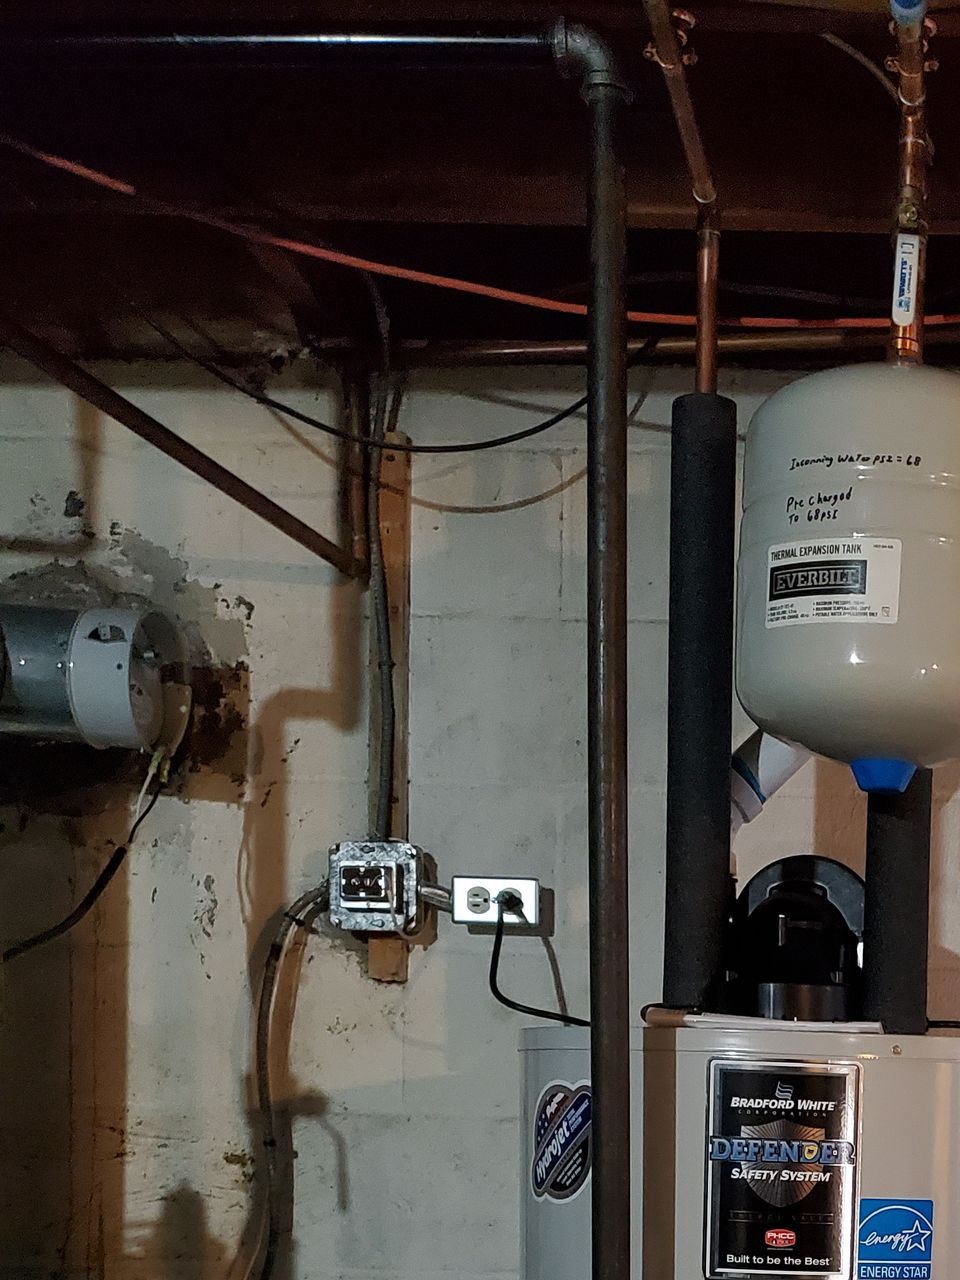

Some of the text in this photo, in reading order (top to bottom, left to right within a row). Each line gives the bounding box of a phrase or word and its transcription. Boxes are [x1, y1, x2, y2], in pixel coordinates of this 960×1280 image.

[906, 455, 922, 466] 68
[786, 496, 804, 512] Pre
[771, 549, 798, 561] THERMAL
[800, 545, 840, 557] EXPANSION
[842, 544, 862, 554] TANK
[776, 569, 857, 590] EVERBILT
[730, 1097, 835, 1111] BRADFORD WHITE
[536, 1120, 570, 1183] Hydrojet
[711, 1137, 855, 1164] DEFENDER
[730, 1169, 830, 1182] SAFETY SYSTEM
[860, 1232, 911, 1252] energy
[726, 1254, 750, 1263] Built
[766, 1256, 781, 1264] be
[784, 1256, 802, 1264] the
[804, 1257, 830, 1266] Best
[860, 1266, 928, 1278] ENERGY STAR
